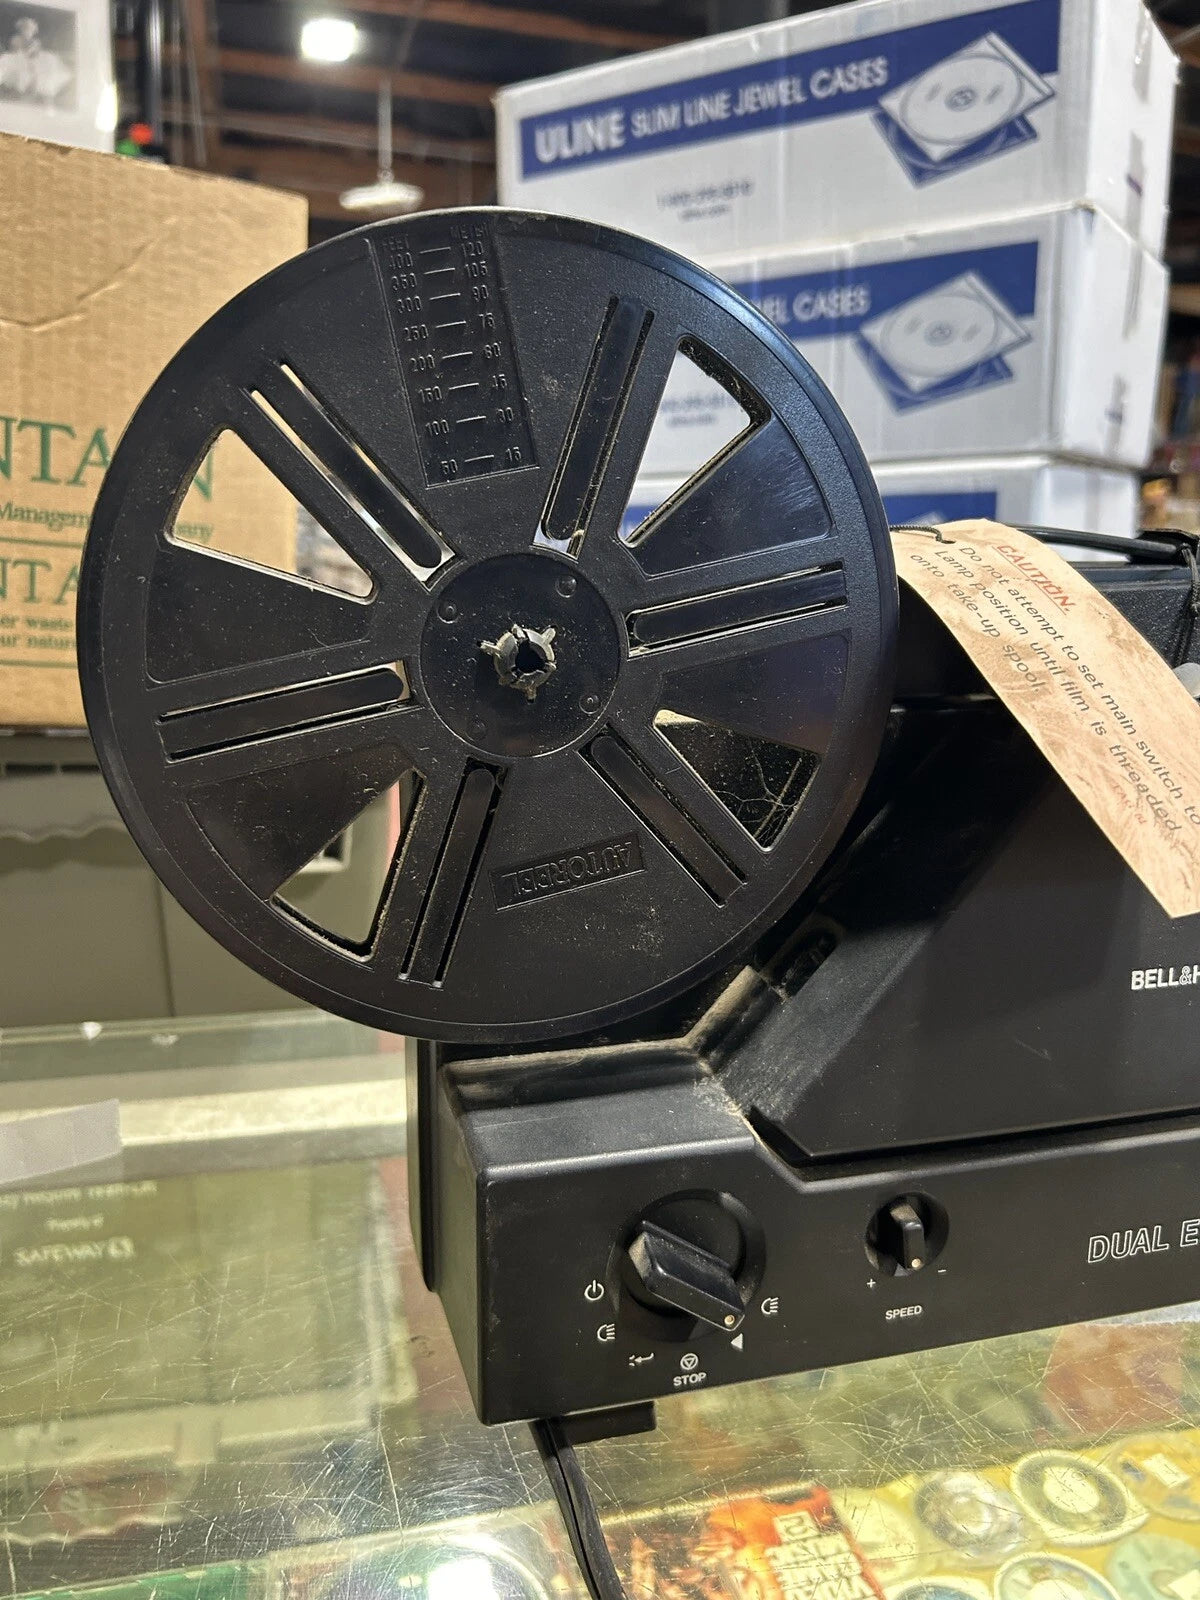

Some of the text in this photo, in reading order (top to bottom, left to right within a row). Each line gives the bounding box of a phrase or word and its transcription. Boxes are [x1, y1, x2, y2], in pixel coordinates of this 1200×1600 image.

[534, 56, 888, 163] ULINE SLIM LINE JEWEL CASES
[461, 241, 483, 257] 120
[391, 260, 488, 291] 350 105
[397, 284, 489, 314] 300 90
[792, 284, 871, 322] CASES
[403, 324, 429, 341] 250
[409, 354, 435, 372] 200
[418, 386, 442, 403] 150
[425, 407, 514, 436] 100 30
[441, 446, 522, 475] 50 15
[910, 554, 1047, 693] onto take-up spool.
[935, 550, 974, 579] Lamp
[970, 583, 1029, 636] position
[1029, 641, 1066, 676] until
[1060, 681, 1090, 712] film
[1090, 721, 1107, 736] is
[1108, 744, 1182, 832] threaded
[959, 547, 1200, 825] Do not attempt to set main switch to
[500, 841, 633, 897] AUTOREEL
[1088, 1225, 1169, 1263] DUAL
[885, 1304, 923, 1321] SPEED
[673, 1372, 707, 1388] STOP
